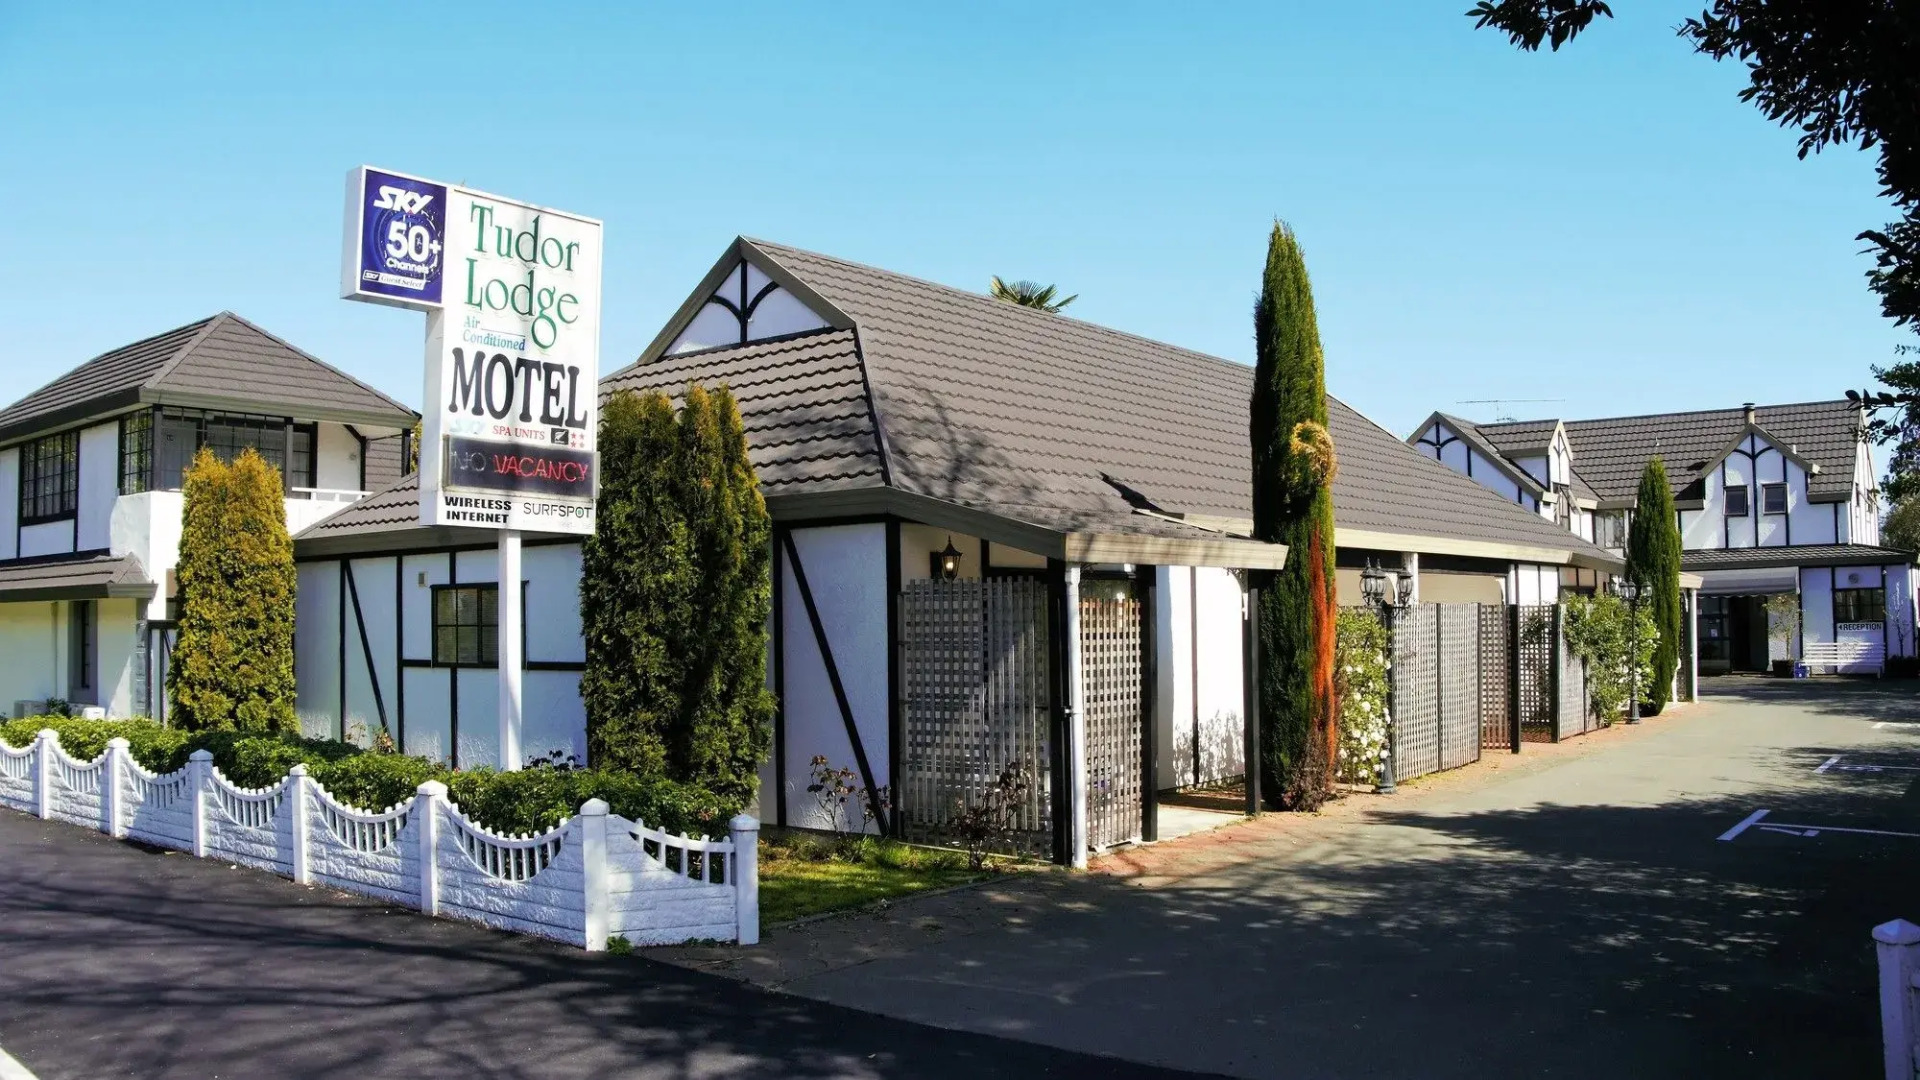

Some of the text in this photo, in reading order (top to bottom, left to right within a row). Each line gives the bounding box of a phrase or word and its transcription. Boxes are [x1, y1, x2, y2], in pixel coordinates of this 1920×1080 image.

[373, 185, 434, 214] SKY
[386, 221, 441, 262] 50+
[470, 201, 580, 271] Tudor
[386, 257, 429, 275] Channels
[464, 257, 579, 349] Lodge
[463, 315, 481, 329] Air
[463, 329, 526, 351] Conditioned
[448, 347, 588, 430] MOTEL
[492, 425, 512, 437] SPA
[514, 427, 545, 440] UNITS
[451, 451, 589, 482] NO VACANCY
[445, 495, 512, 511] WIRELESS
[523, 502, 592, 518] SURFSPOT
[446, 510, 509, 524] INTERNET
[1843, 623, 1882, 631] RECEPTION
